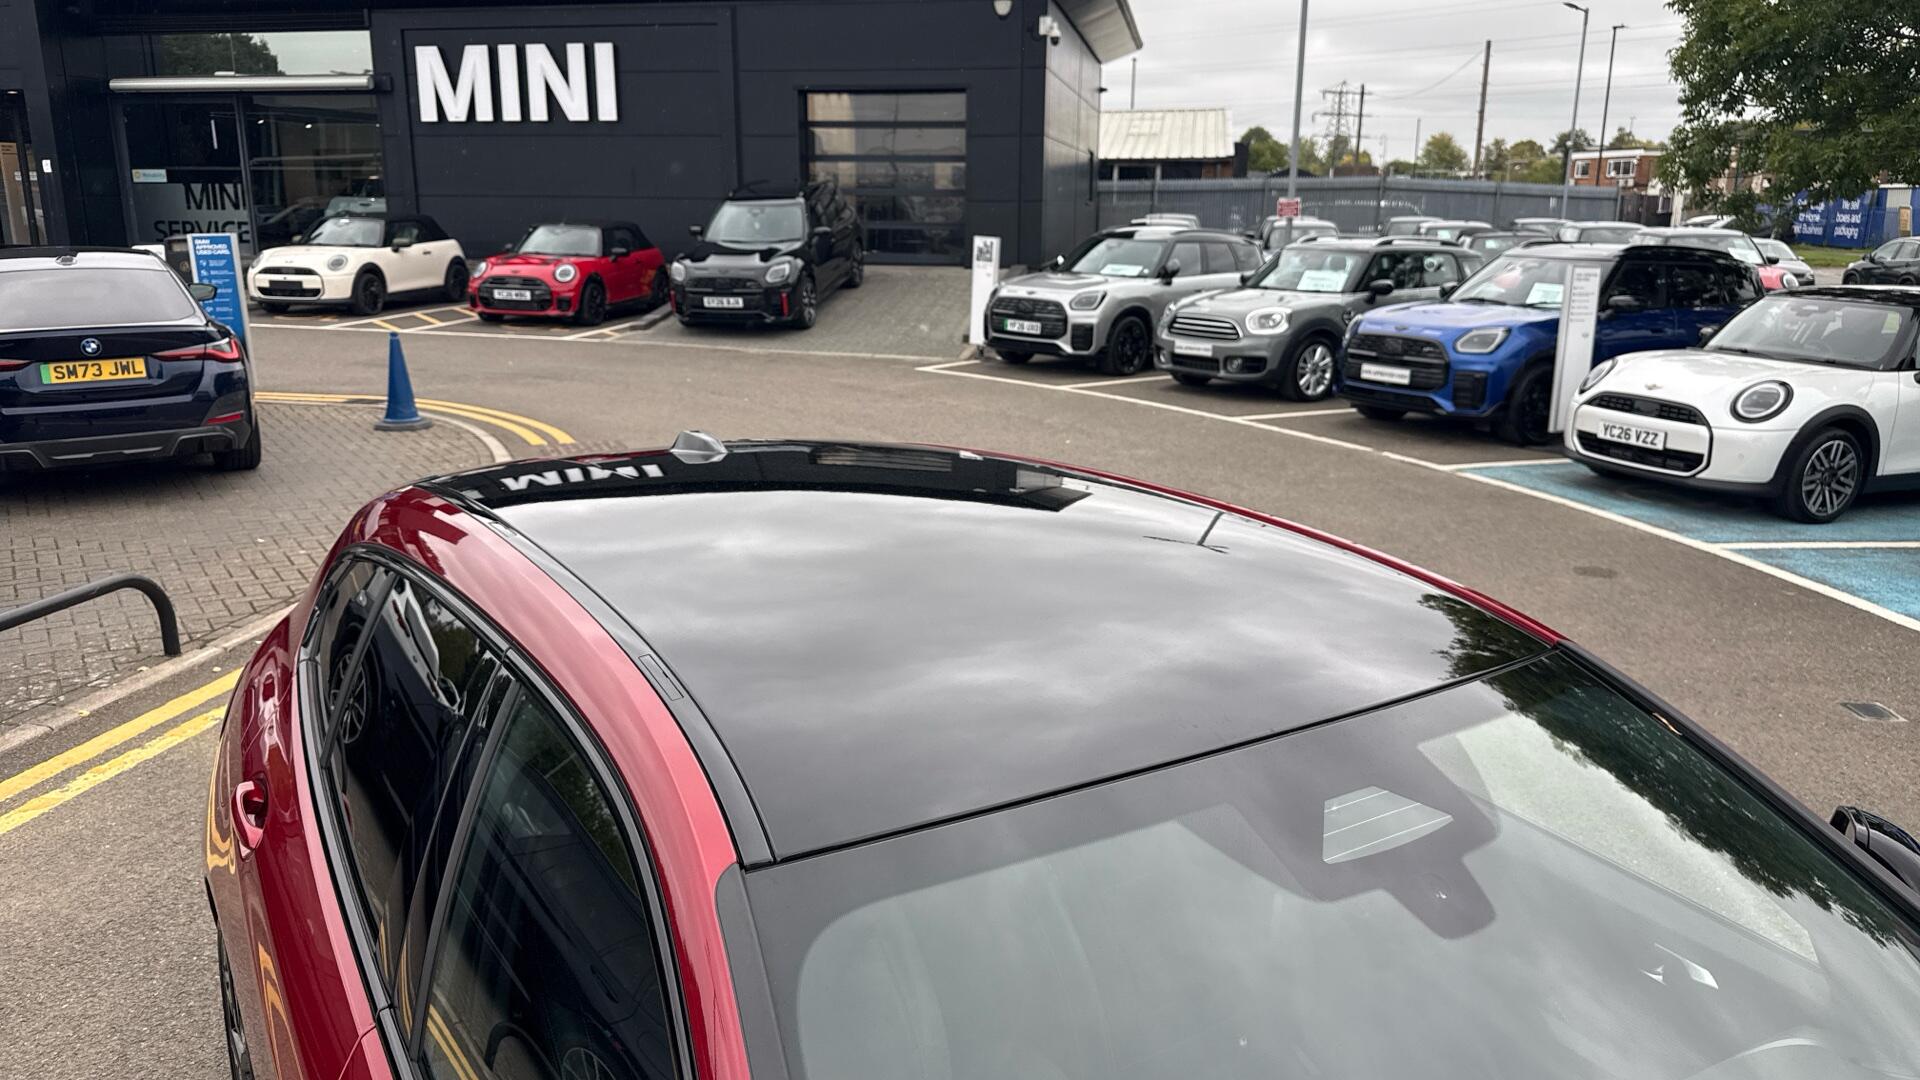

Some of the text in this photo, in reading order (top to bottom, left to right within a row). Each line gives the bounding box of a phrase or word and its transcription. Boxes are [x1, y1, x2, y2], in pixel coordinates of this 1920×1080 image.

[414, 42, 618, 122] MINI
[184, 183, 246, 210] MINI
[54, 360, 143, 380] SM73 JWL
[1603, 423, 1658, 446] YC26 VZZ
